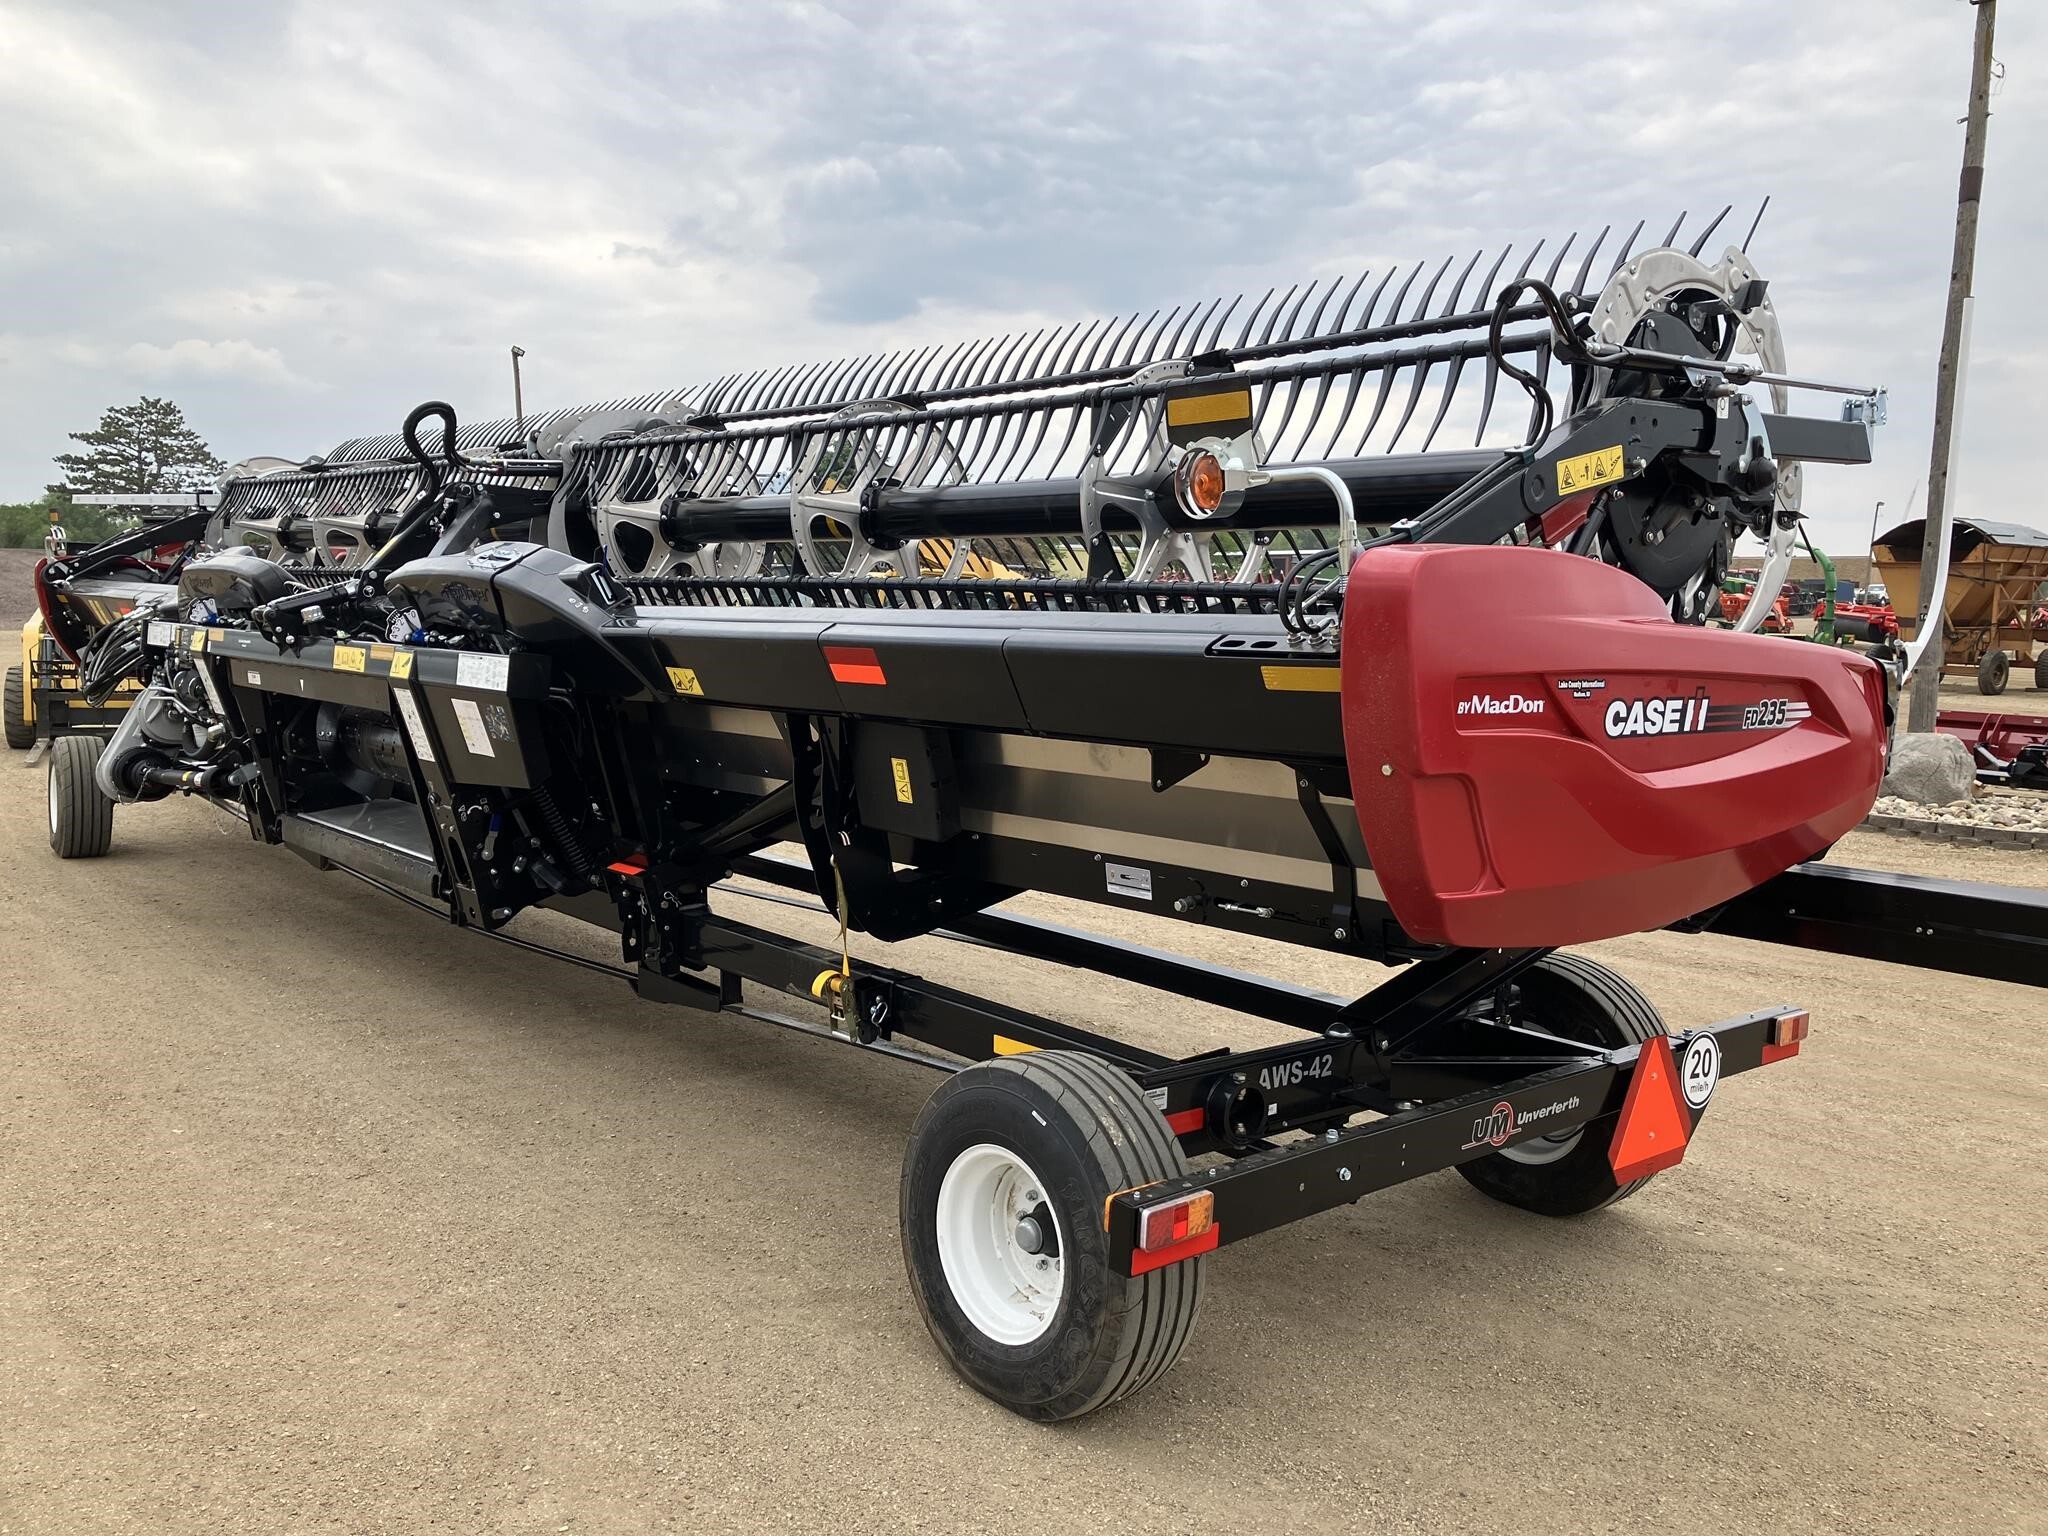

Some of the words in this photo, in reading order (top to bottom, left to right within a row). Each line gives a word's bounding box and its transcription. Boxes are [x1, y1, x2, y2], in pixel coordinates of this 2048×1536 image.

[1457, 702, 1471, 714] BY
[1471, 694, 1545, 714] MacDon
[1604, 699, 1684, 737] CASE
[1742, 700, 1789, 730] FD235
[1689, 1047, 1712, 1079] 20
[1516, 1096, 1580, 1125] Unverferth
